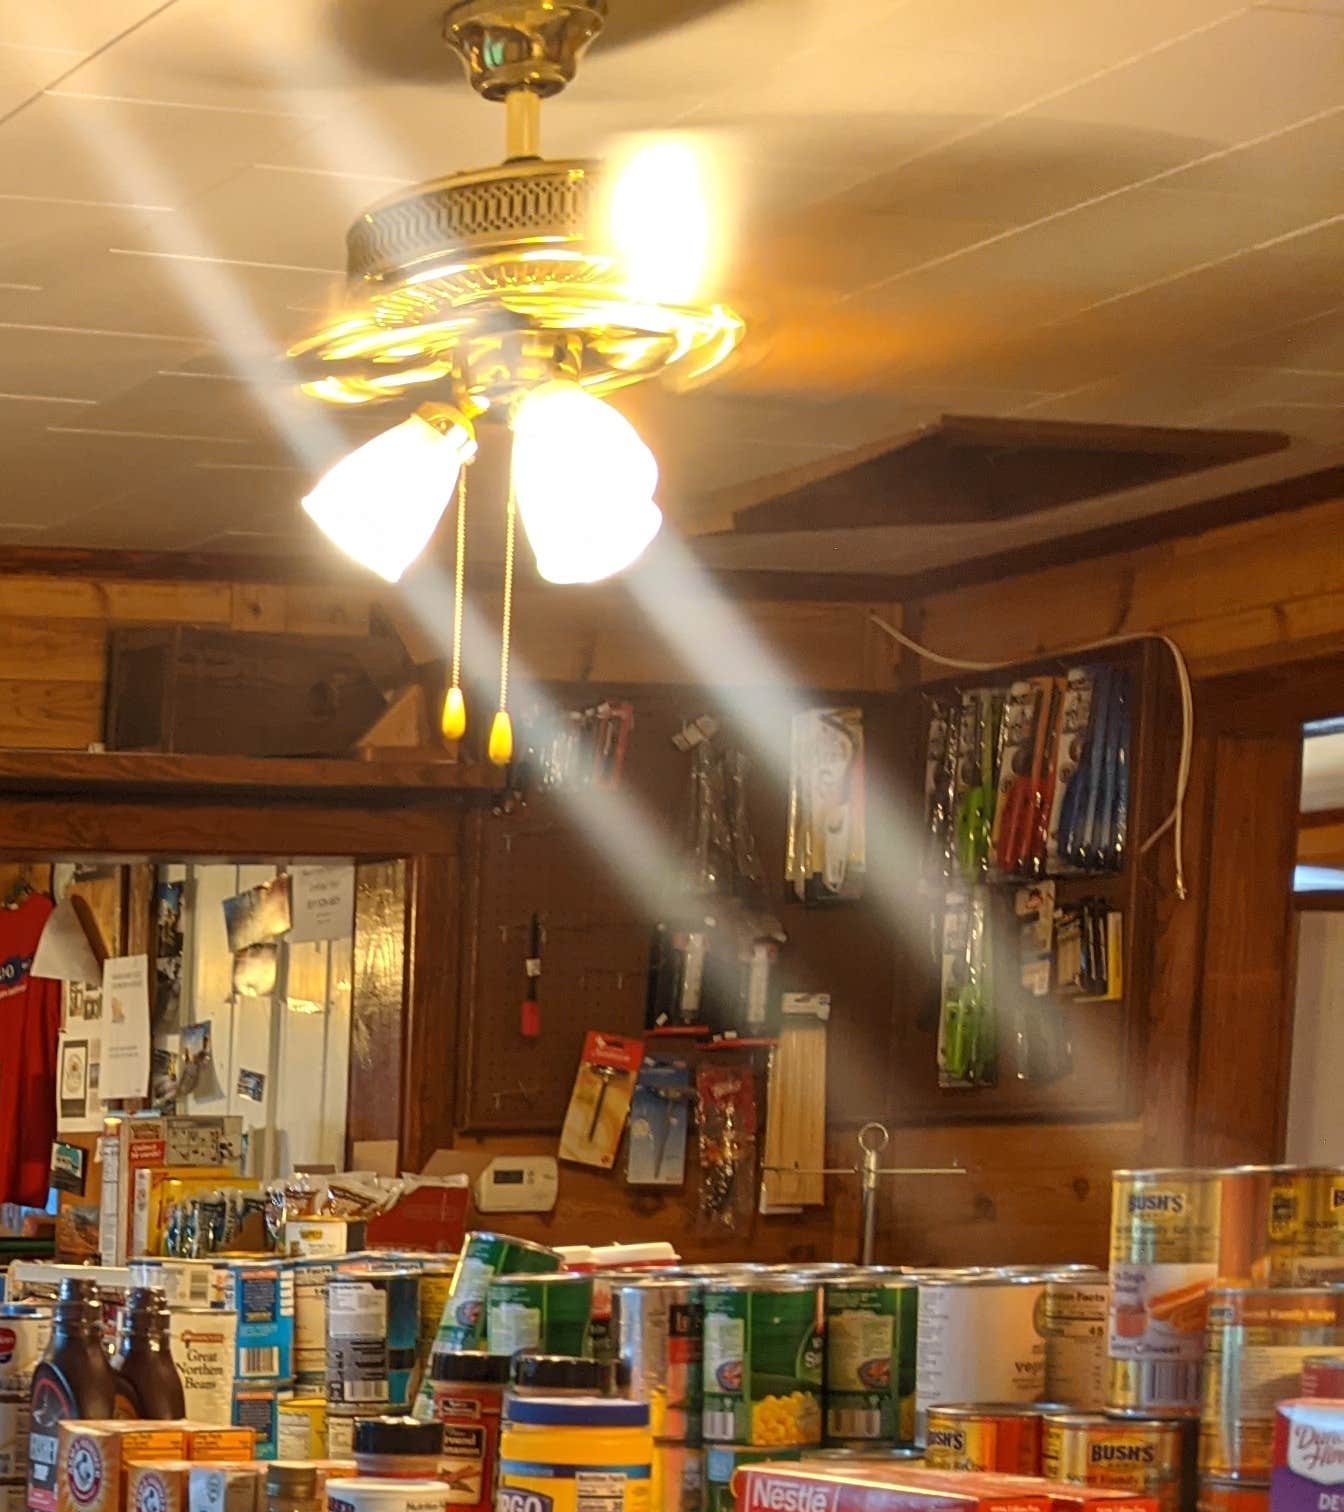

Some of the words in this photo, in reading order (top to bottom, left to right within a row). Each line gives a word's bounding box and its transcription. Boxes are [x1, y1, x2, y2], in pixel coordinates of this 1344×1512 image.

[1127, 1193, 1184, 1214] BUSH'S
[186, 1347, 218, 1364] Great
[184, 1376, 217, 1391] Beans
[1091, 1444, 1154, 1463] BUSH'S
